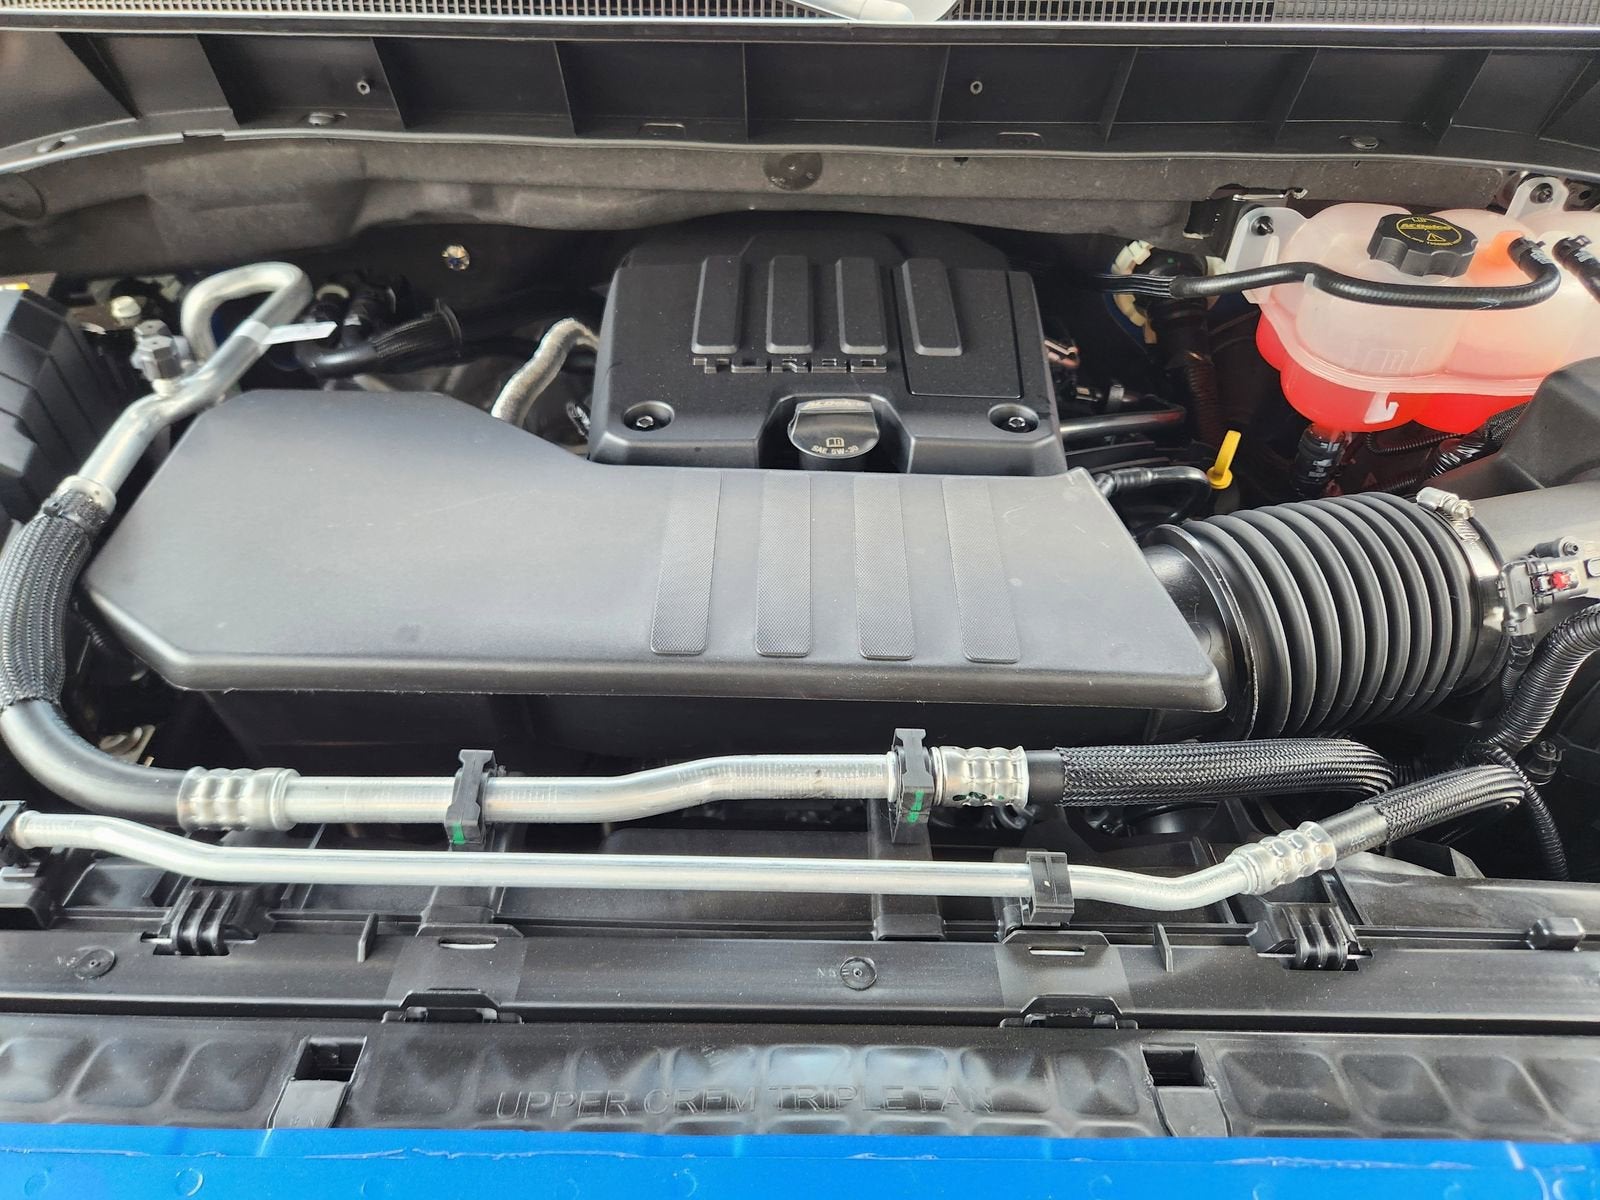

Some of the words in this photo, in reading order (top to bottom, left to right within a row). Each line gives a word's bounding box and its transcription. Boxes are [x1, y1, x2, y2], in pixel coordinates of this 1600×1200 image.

[1400, 223, 1452, 231] ACDelco
[692, 356, 888, 375] TURBO
[496, 1089, 631, 1119] UPPER
[767, 1084, 908, 1113] TRIPLE
[917, 1084, 996, 1113] FAN
